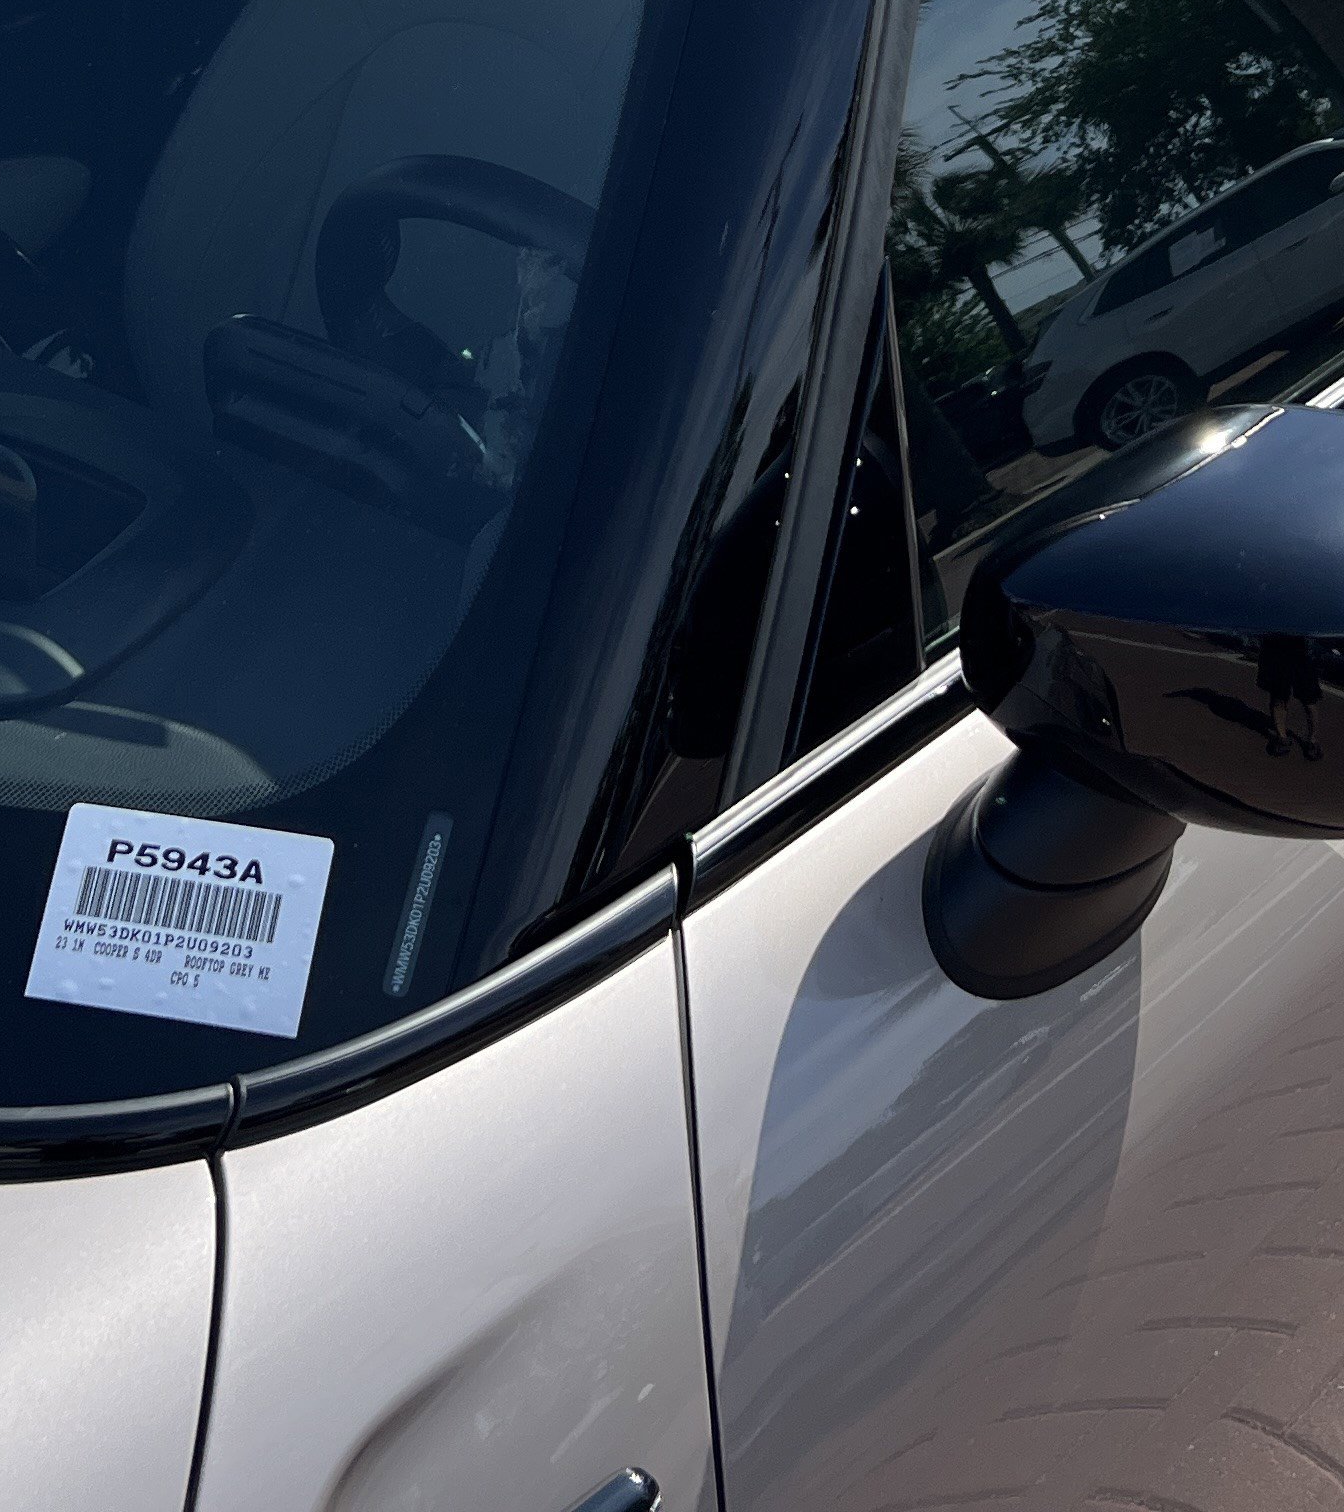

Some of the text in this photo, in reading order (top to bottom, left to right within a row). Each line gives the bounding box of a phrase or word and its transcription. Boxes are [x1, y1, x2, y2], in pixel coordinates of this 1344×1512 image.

[107, 839, 263, 884] P5943A
[54, 935, 68, 949] 23
[93, 941, 129, 958] COOPER
[132, 947, 141, 961] S
[144, 948, 162, 963] 4DR
[184, 954, 226, 973] ROOFTOP
[230, 961, 254, 978] GREY
[63, 918, 253, 959] WMW53DK01P2U09203
[170, 971, 189, 987] CPO
